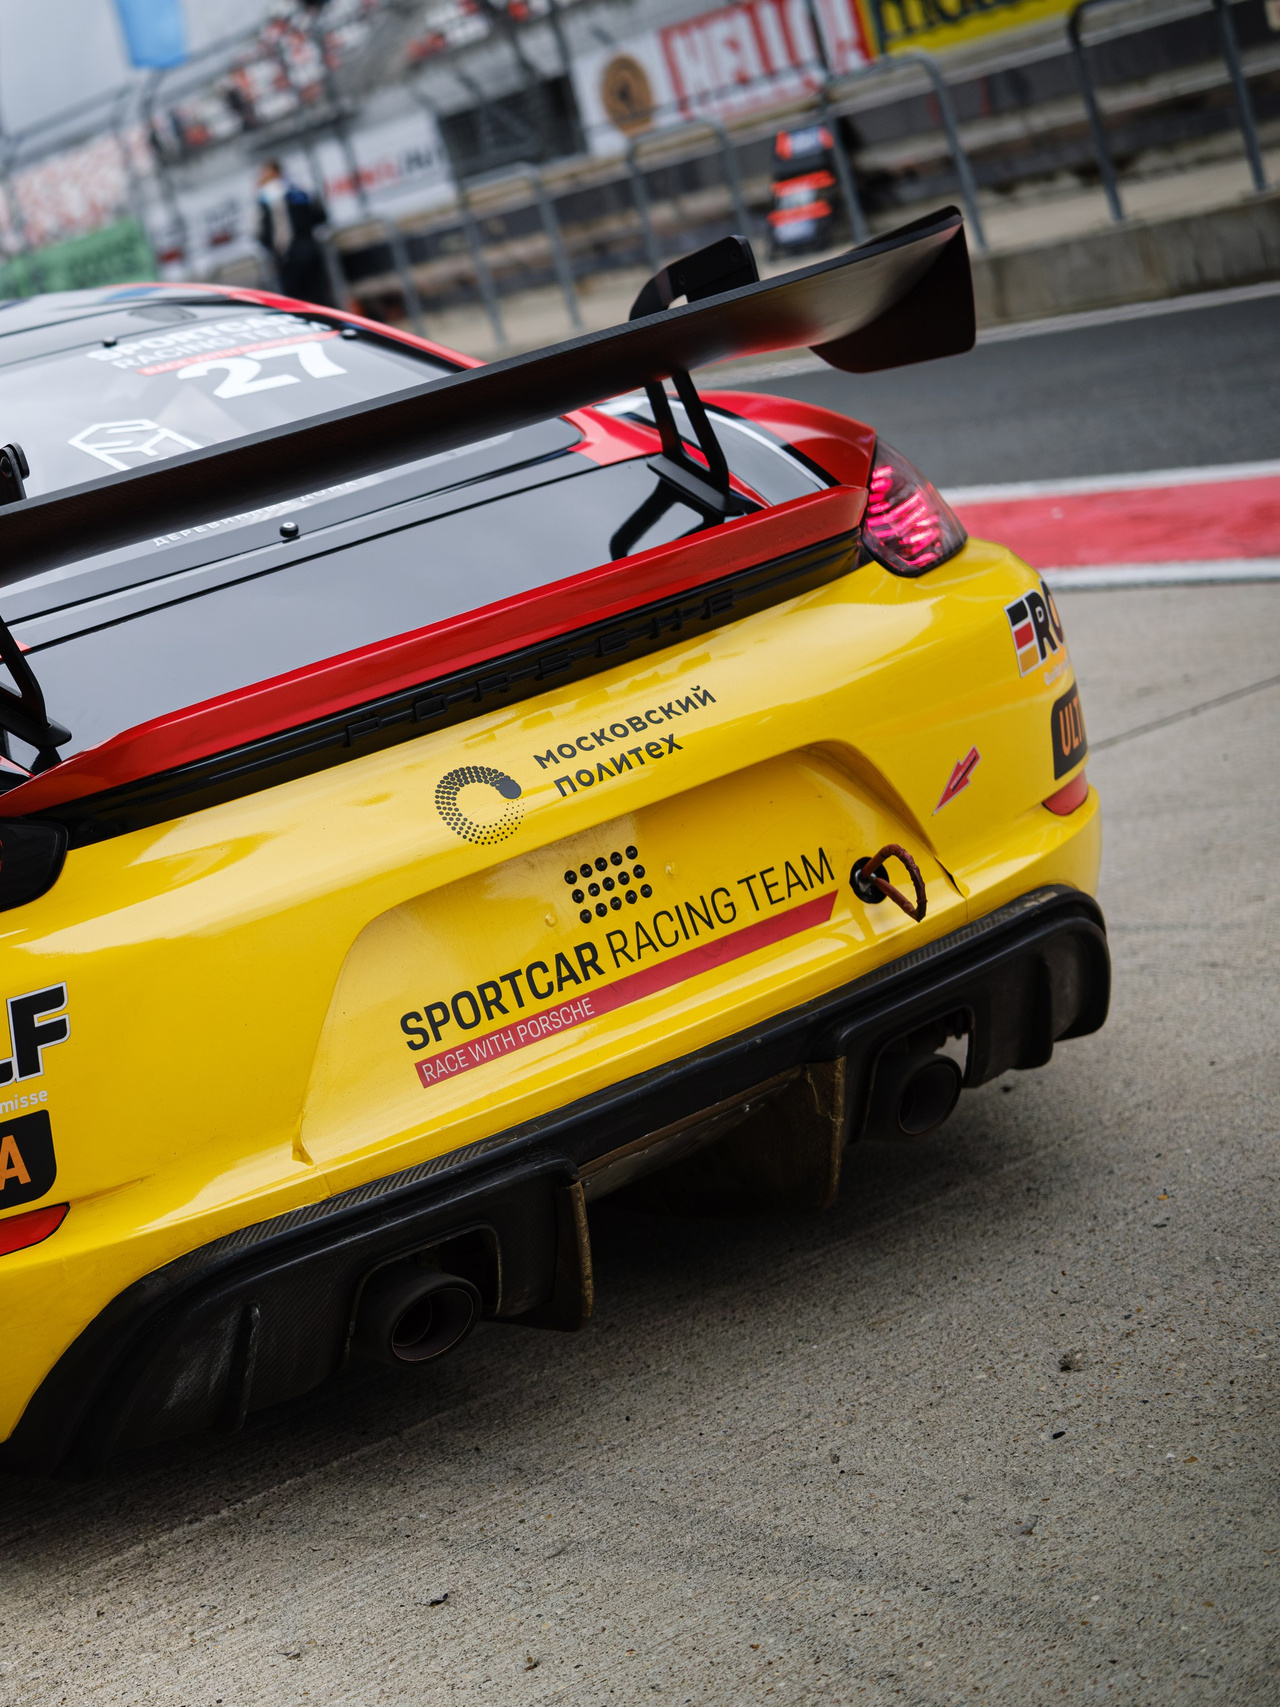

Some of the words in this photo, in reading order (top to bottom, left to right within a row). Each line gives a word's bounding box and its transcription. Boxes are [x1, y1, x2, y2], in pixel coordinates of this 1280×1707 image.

[177, 341, 348, 399] 27
[400, 941, 606, 1051] SPORTCAR
[606, 887, 737, 968] RACING
[736, 847, 835, 912] TEAM
[422, 1049, 469, 1082] RACE
[472, 1028, 516, 1063] WITH
[518, 998, 595, 1043] PORSCHE
